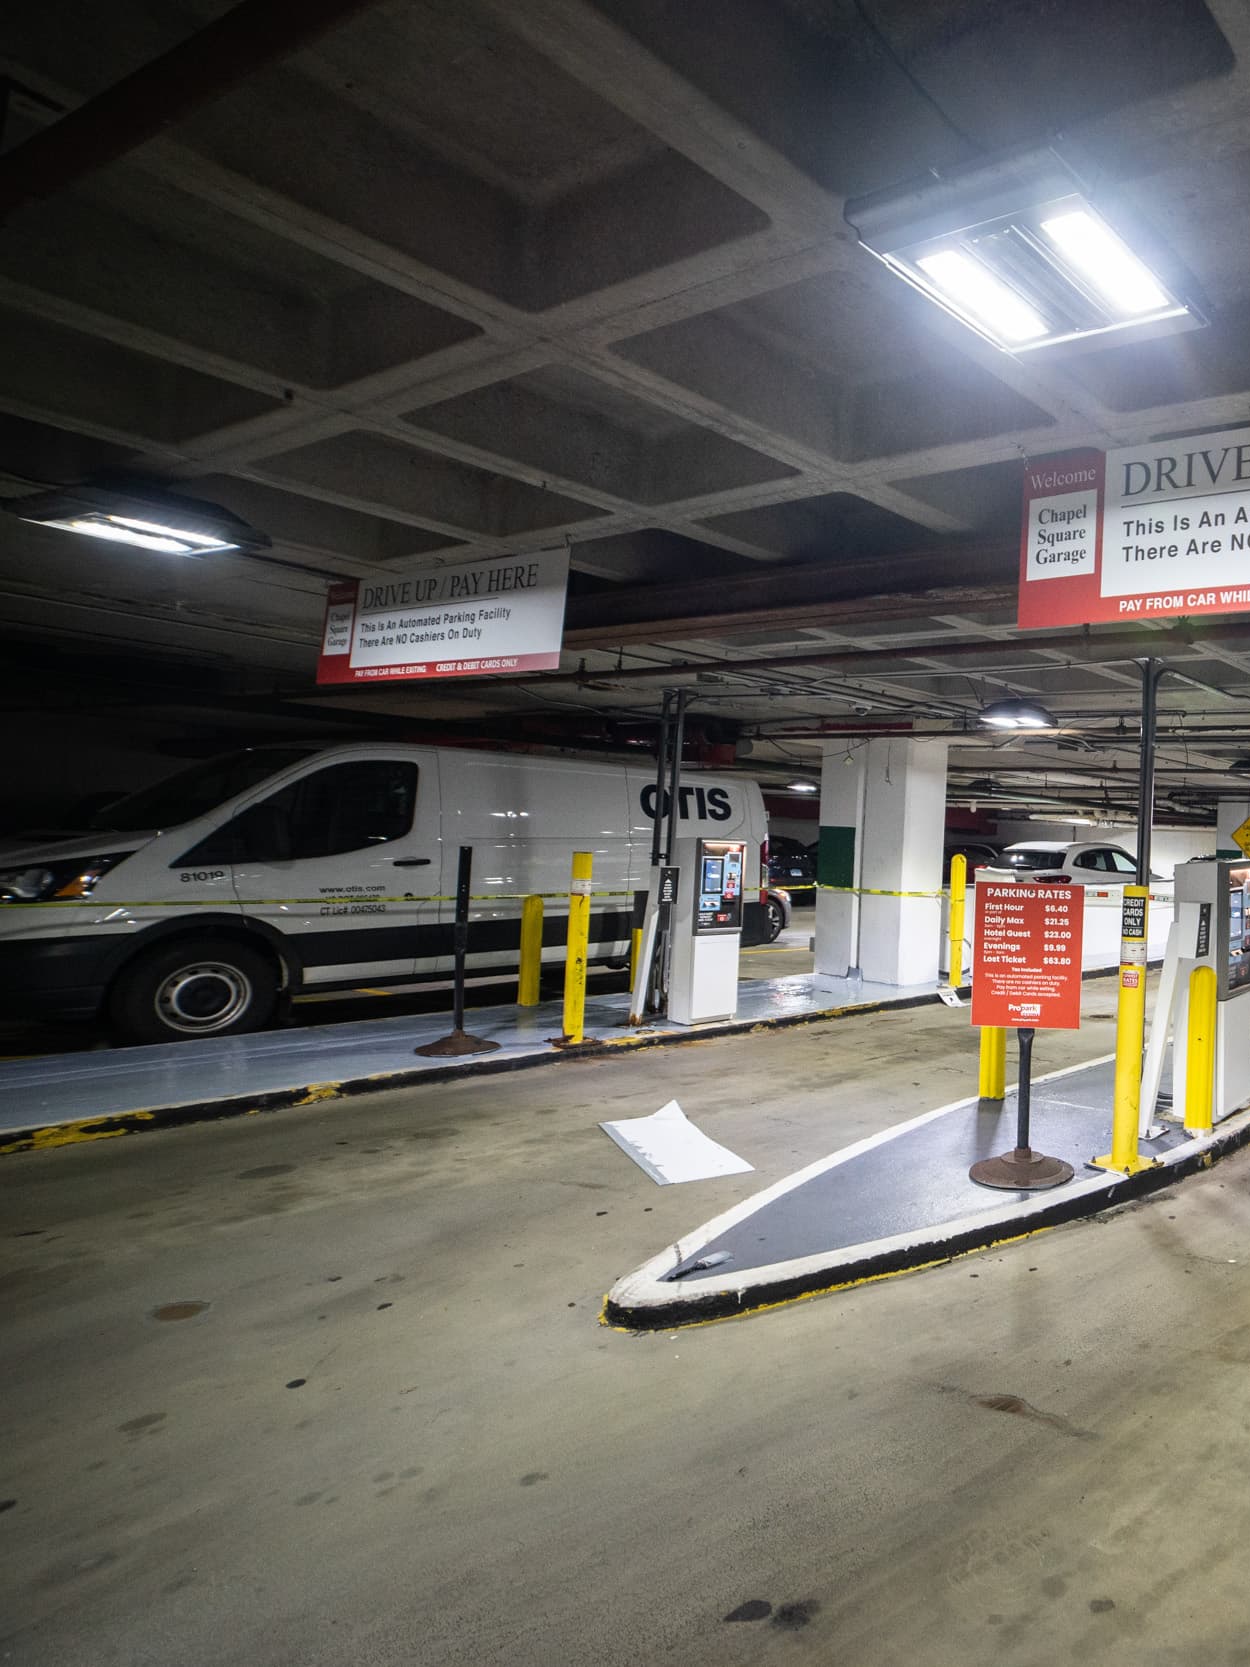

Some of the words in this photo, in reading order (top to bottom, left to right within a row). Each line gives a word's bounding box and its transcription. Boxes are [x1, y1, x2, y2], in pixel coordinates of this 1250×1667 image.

[1030, 466, 1097, 490] Welcome
[1038, 504, 1087, 526] Chapel
[1123, 519, 1164, 538] This
[1173, 515, 1190, 531] Is
[1199, 509, 1226, 528] An
[1037, 526, 1086, 546] Square
[1035, 548, 1087, 567] Garage
[1122, 543, 1178, 563] There
[1186, 538, 1222, 557] Are
[362, 582, 411, 610] DRIVE
[415, 578, 437, 603] UP
[439, 576, 448, 601] /
[450, 571, 486, 598] PAY
[488, 564, 540, 592] HERE
[1119, 598, 1143, 613] PAY
[1146, 595, 1183, 611] FROM
[1186, 592, 1216, 608] CAR
[361, 623, 376, 633] This
[378, 622, 385, 632] Is
[386, 620, 397, 630] An
[399, 615, 441, 629] Automated
[443, 611, 476, 624] Parking
[479, 608, 512, 621] Facility
[327, 636, 348, 648] Garage
[360, 637, 379, 648] There
[381, 636, 394, 646] Are
[396, 633, 407, 644] NO
[410, 630, 445, 643] Cashiers
[448, 629, 460, 640] On
[462, 627, 482, 639] Duty
[378, 668, 389, 676] CAR
[406, 665, 426, 673] EXITING
[436, 663, 456, 672] CREDIT
[457, 662, 463, 670] &
[463, 661, 480, 670] DEBIT
[481, 660, 501, 669] CARDS
[501, 658, 518, 668] ONLY
[640, 784, 732, 821] OTIS
[987, 888, 1036, 898] PARKING
[1038, 889, 1072, 900] RATES
[1004, 903, 1024, 911] Hour
[985, 916, 1005, 925] Daily
[1124, 917, 1141, 926] ONLY
[984, 929, 1005, 937] Hotel
[1006, 930, 1031, 938] Guest
[1128, 928, 1143, 936] CASH
[984, 942, 1021, 952] Evenings
[984, 955, 1000, 963] Lost
[1001, 955, 1027, 964] Ticket
